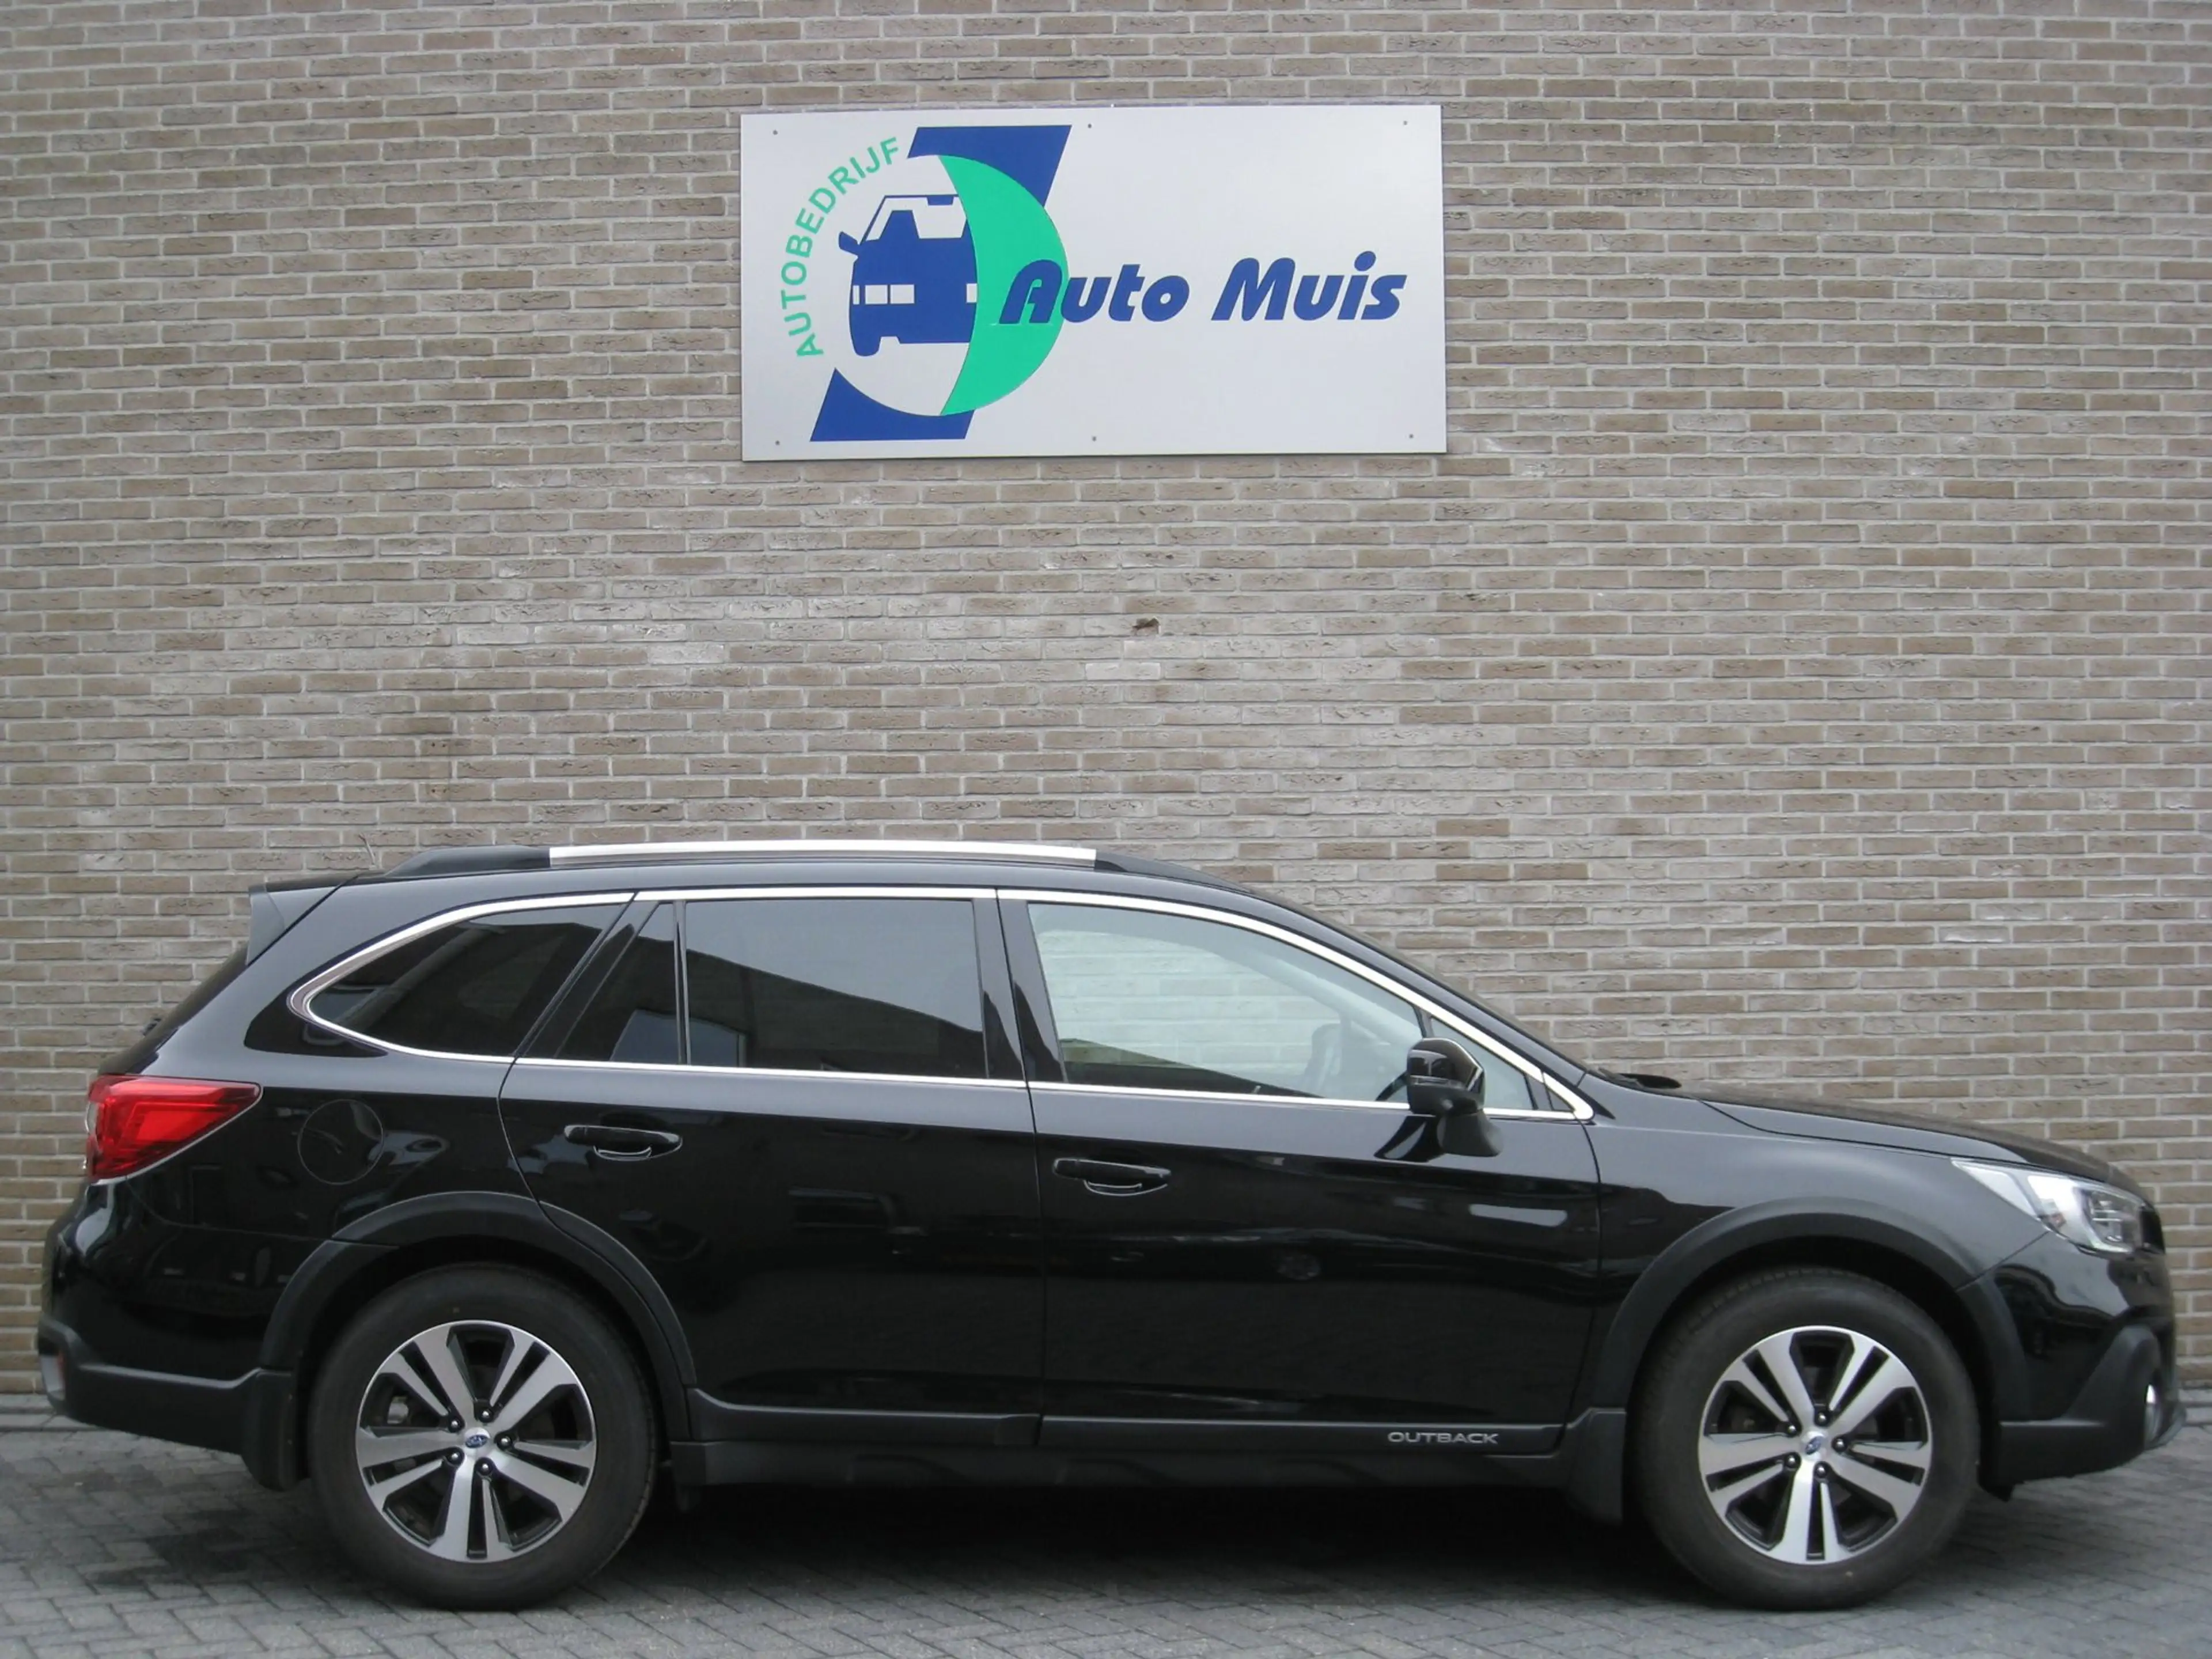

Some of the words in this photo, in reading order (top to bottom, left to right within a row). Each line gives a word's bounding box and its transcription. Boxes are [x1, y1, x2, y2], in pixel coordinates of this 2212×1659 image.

[781, 137, 900, 357] AUTOBEDRIJF
[1000, 259, 1190, 323] Auto
[1211, 251, 1407, 321] Muis
[1387, 1431, 1499, 1444] OUTBACK
